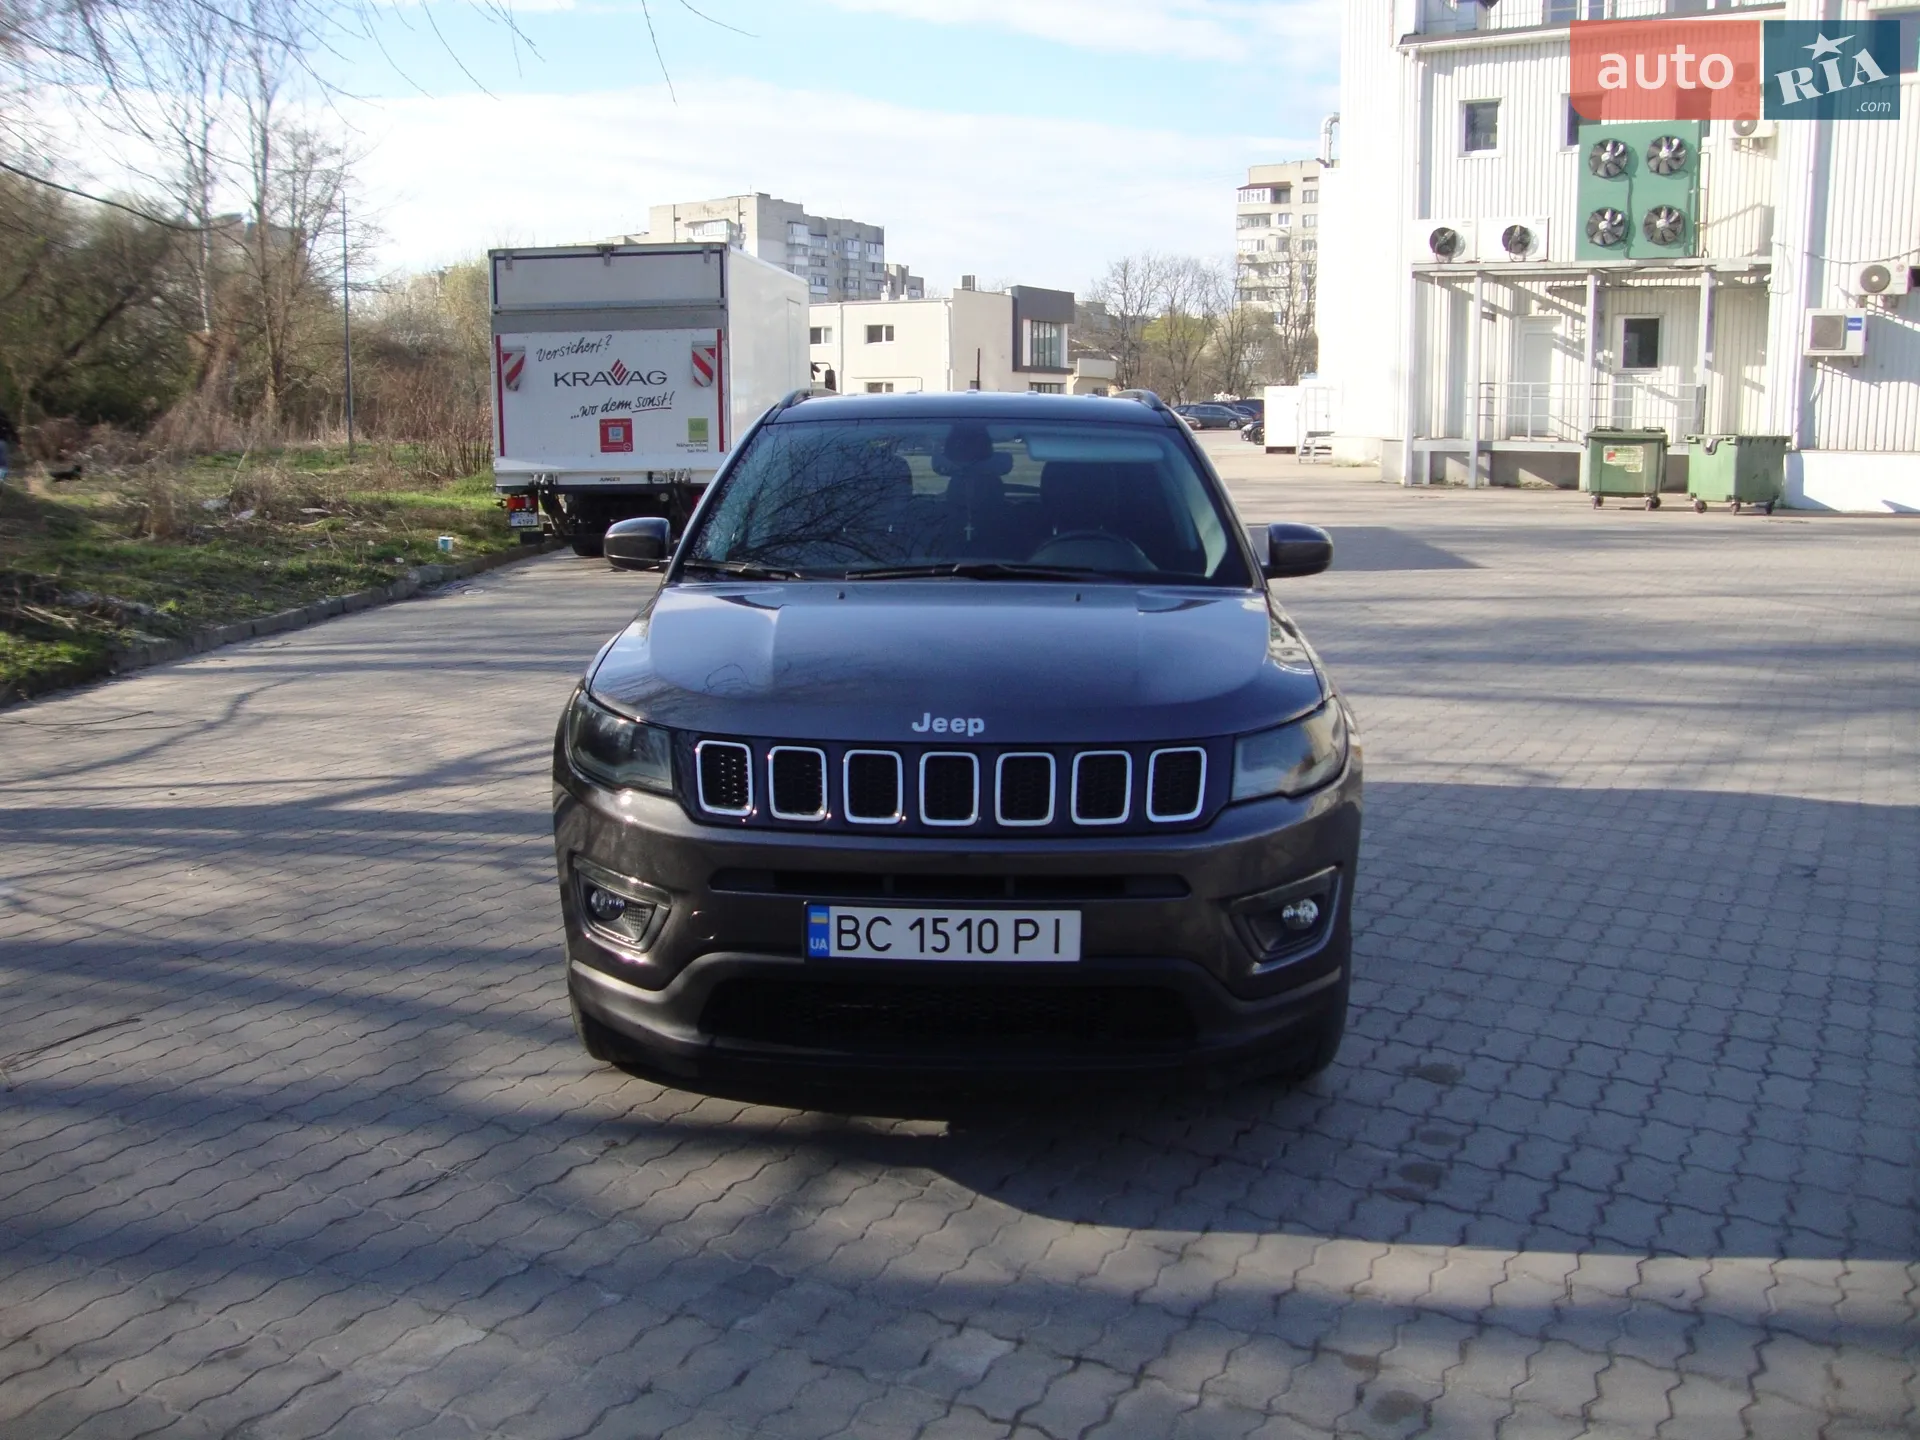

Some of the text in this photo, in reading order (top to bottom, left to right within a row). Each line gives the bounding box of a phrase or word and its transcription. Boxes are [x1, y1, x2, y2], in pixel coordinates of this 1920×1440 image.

[536, 334, 612, 362] Versichert?
[553, 370, 668, 387] KRAVAG
[601, 397, 632, 413] denn
[635, 391, 675, 409] sonst!
[912, 712, 985, 737] Jeep
[810, 938, 829, 950] UA
[836, 914, 892, 952] BC
[909, 917, 999, 954] 1510
